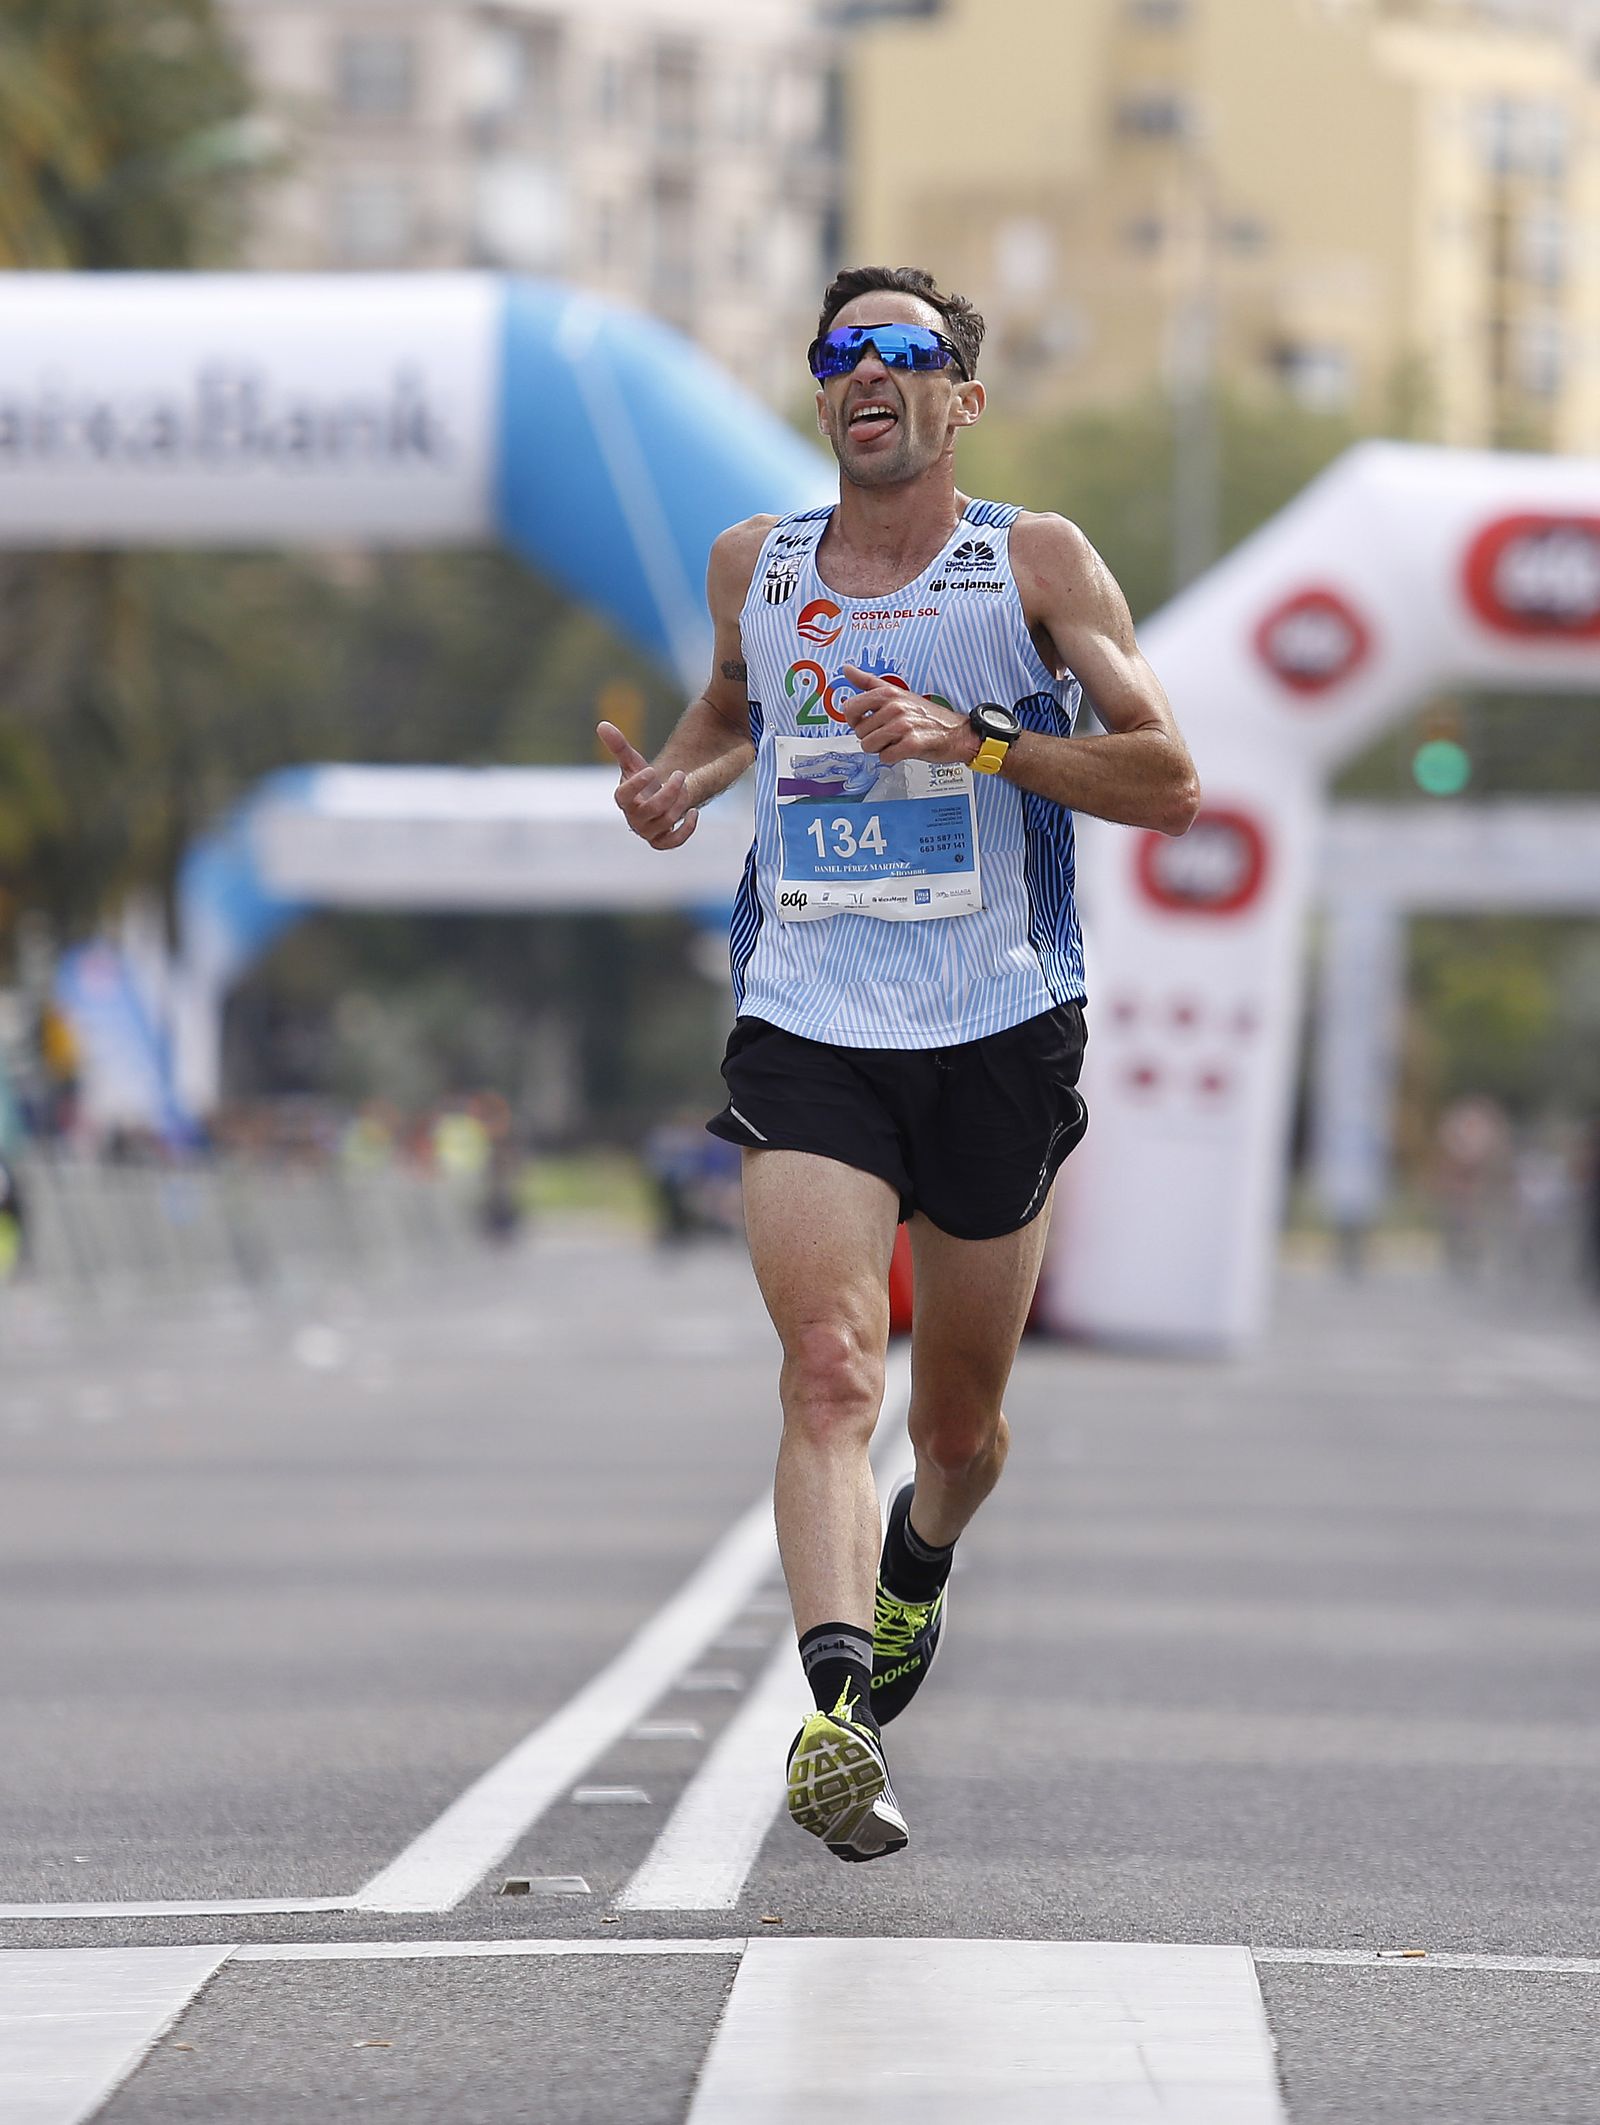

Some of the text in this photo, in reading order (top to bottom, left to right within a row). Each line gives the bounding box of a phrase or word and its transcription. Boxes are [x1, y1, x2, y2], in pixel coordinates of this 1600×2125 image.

[950, 579, 1006, 592] cajamar
[851, 607, 940, 620] COSTA DEL SOL
[807, 815, 888, 858] 134
[954, 832, 965, 840] 111
[920, 845, 935, 853] 663
[953, 841, 966, 849] 141
[814, 861, 911, 873] DANIEL PÉREZ MARTÍNEZ
[781, 889, 808, 912] edp
